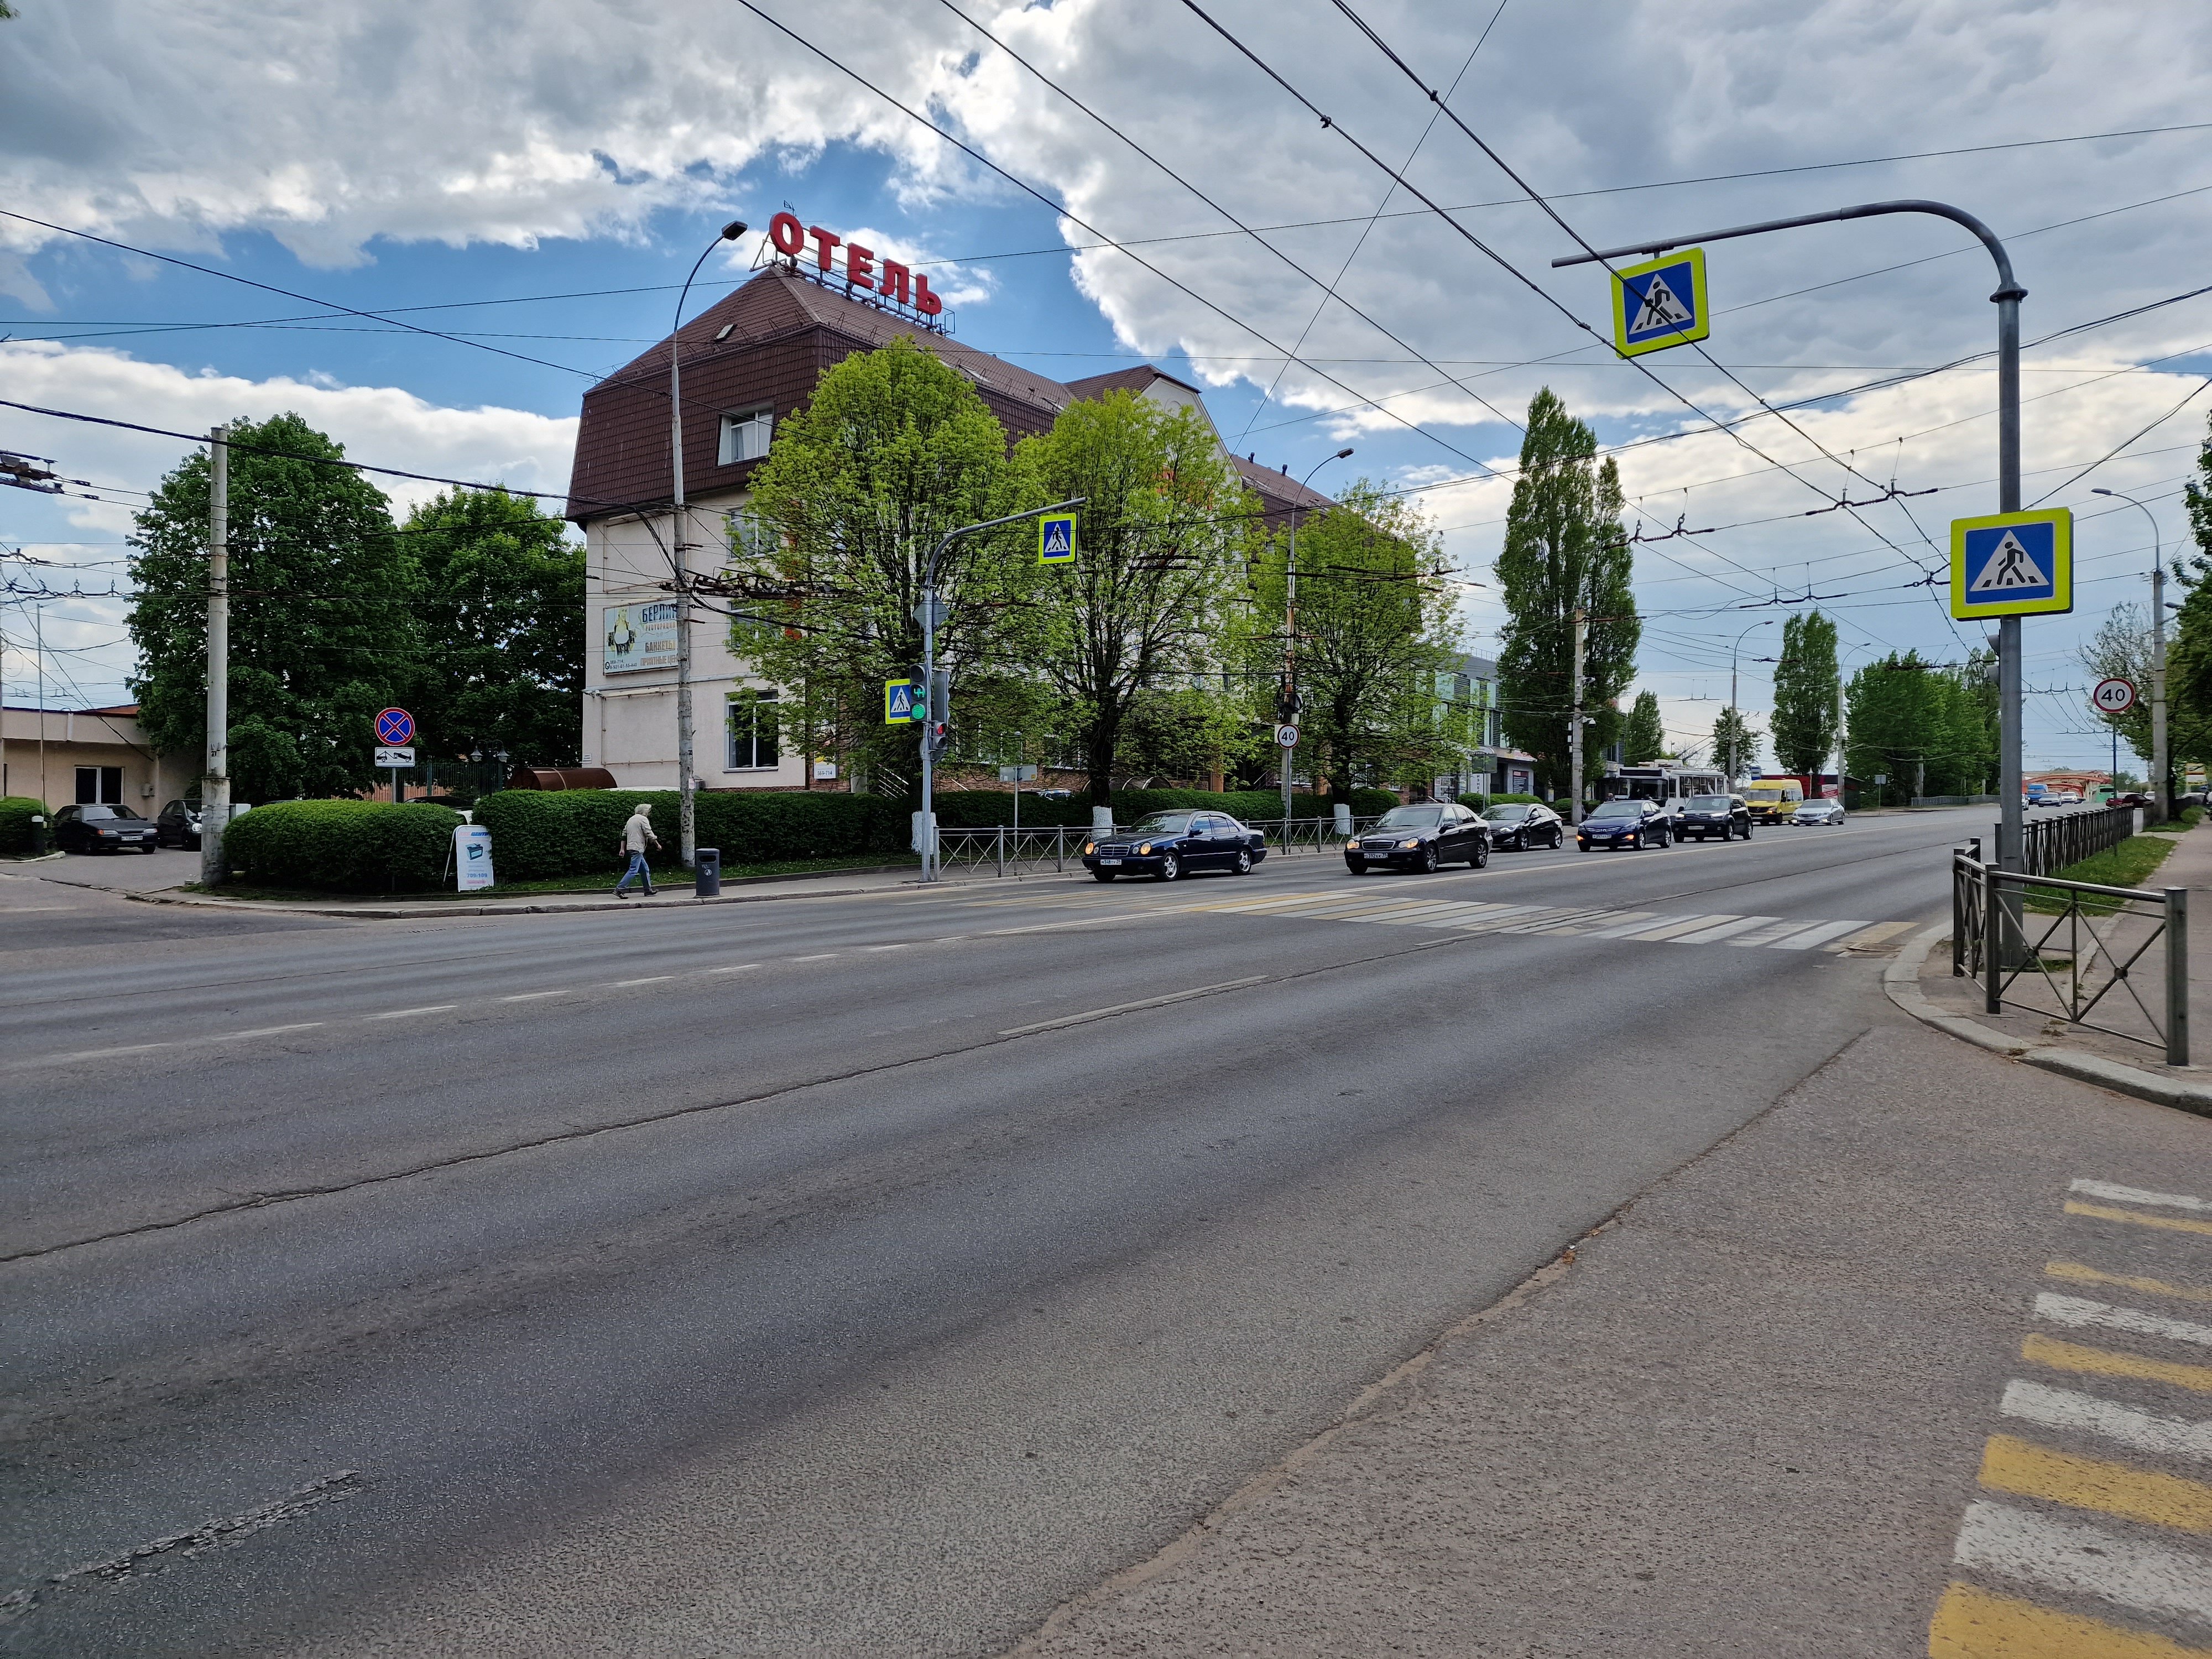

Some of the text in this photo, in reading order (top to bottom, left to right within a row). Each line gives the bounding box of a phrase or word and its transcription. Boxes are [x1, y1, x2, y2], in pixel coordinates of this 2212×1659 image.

[769, 211, 942, 315] ОТЕЛЬ
[645, 639, 676, 653] БАНКЕТЫ
[2101, 688, 2126, 702] 40
[1281, 731, 1295, 741] 40
